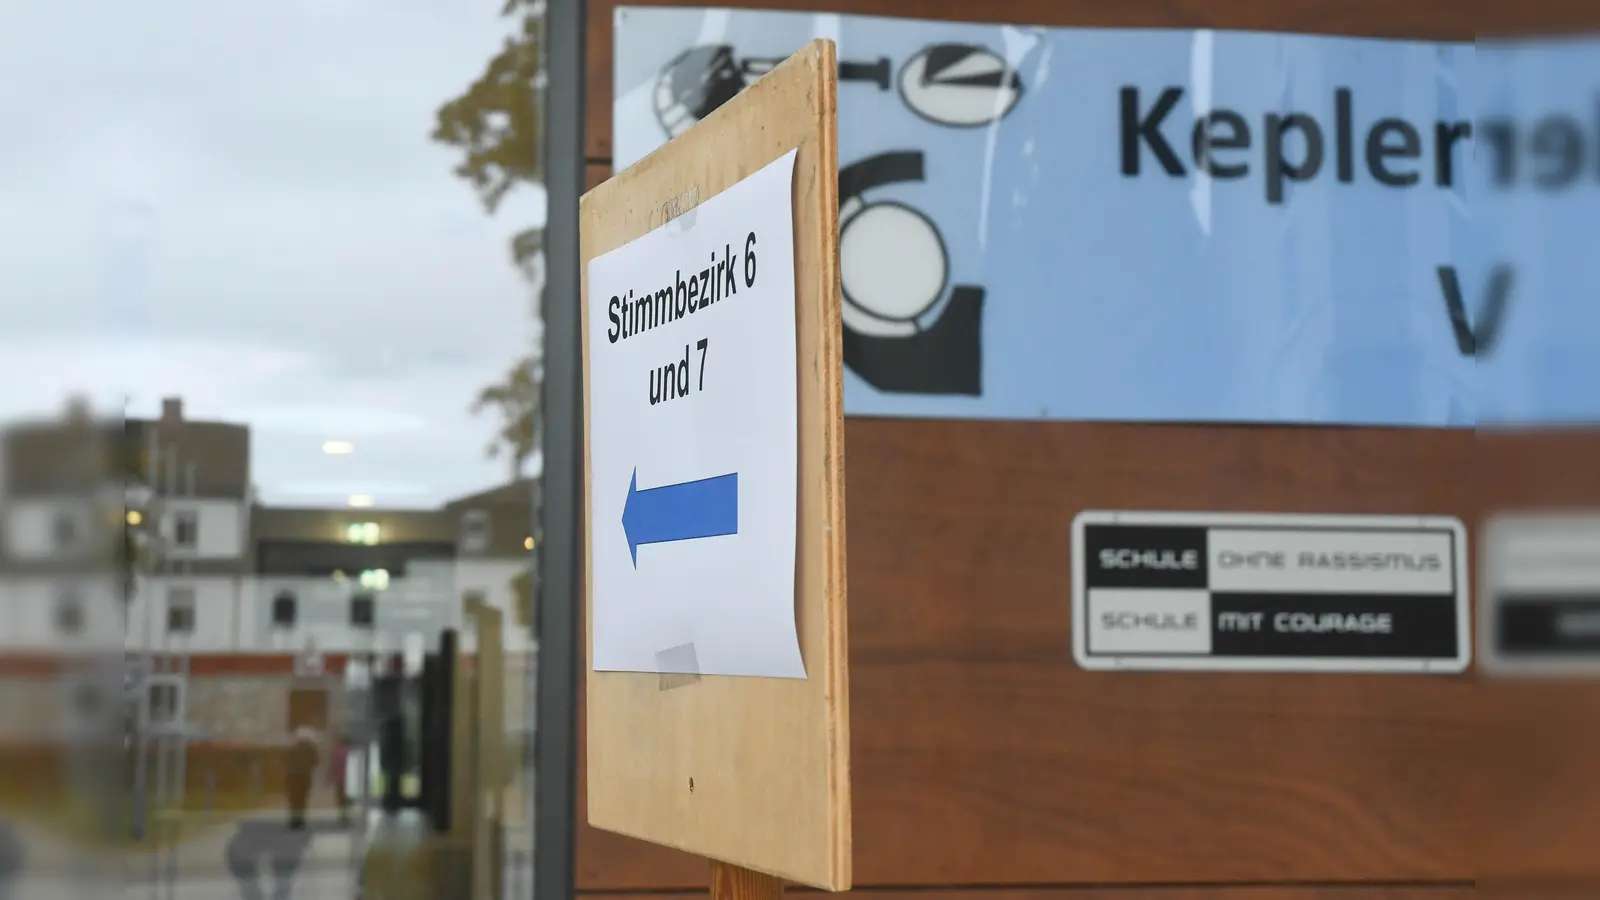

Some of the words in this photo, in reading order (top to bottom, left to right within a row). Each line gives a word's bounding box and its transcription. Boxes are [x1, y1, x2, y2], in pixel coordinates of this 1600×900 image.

[607, 243, 737, 344] Stimmbezirk
[744, 231, 756, 288] 6
[649, 344, 689, 405] und
[697, 337, 708, 391] 7
[1099, 548, 1199, 571] SCHULE
[1217, 550, 1287, 571] OHNE
[1298, 551, 1443, 572] RASSISMUS
[1100, 611, 1199, 631] SCHULE
[1218, 611, 1265, 633] MIT
[1273, 612, 1393, 634] COURAGE
